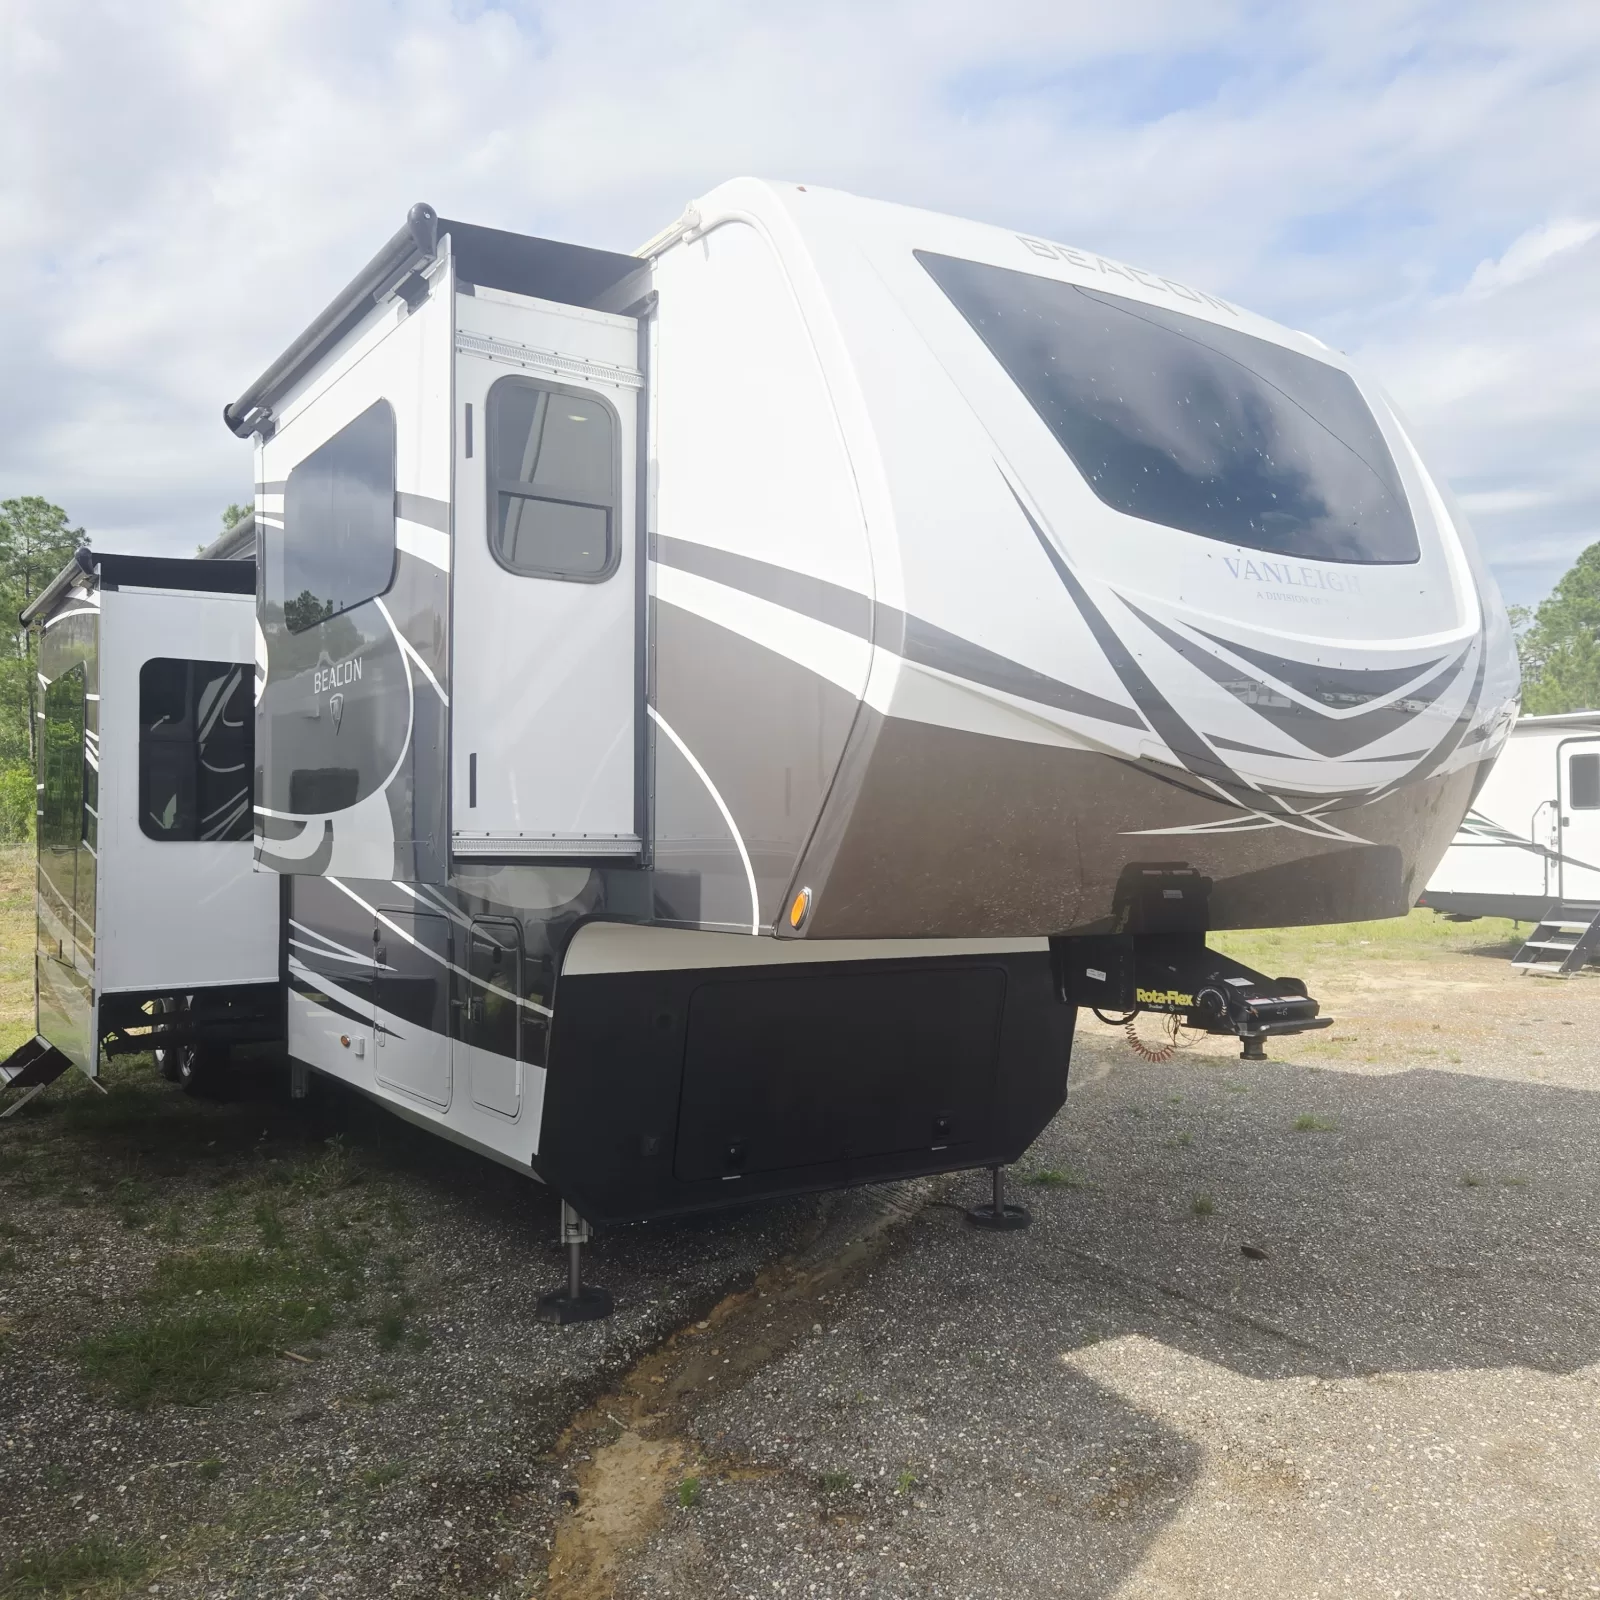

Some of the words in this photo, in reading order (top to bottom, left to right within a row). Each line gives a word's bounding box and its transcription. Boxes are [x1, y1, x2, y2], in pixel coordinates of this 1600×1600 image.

[1015, 234, 1239, 317] BEACON
[1222, 556, 1362, 595] VANLEIGH
[1256, 591, 1264, 600] A
[1265, 591, 1309, 604] DIVISION
[314, 656, 362, 694] BEACON
[1136, 987, 1194, 1007] Rota-Flex
